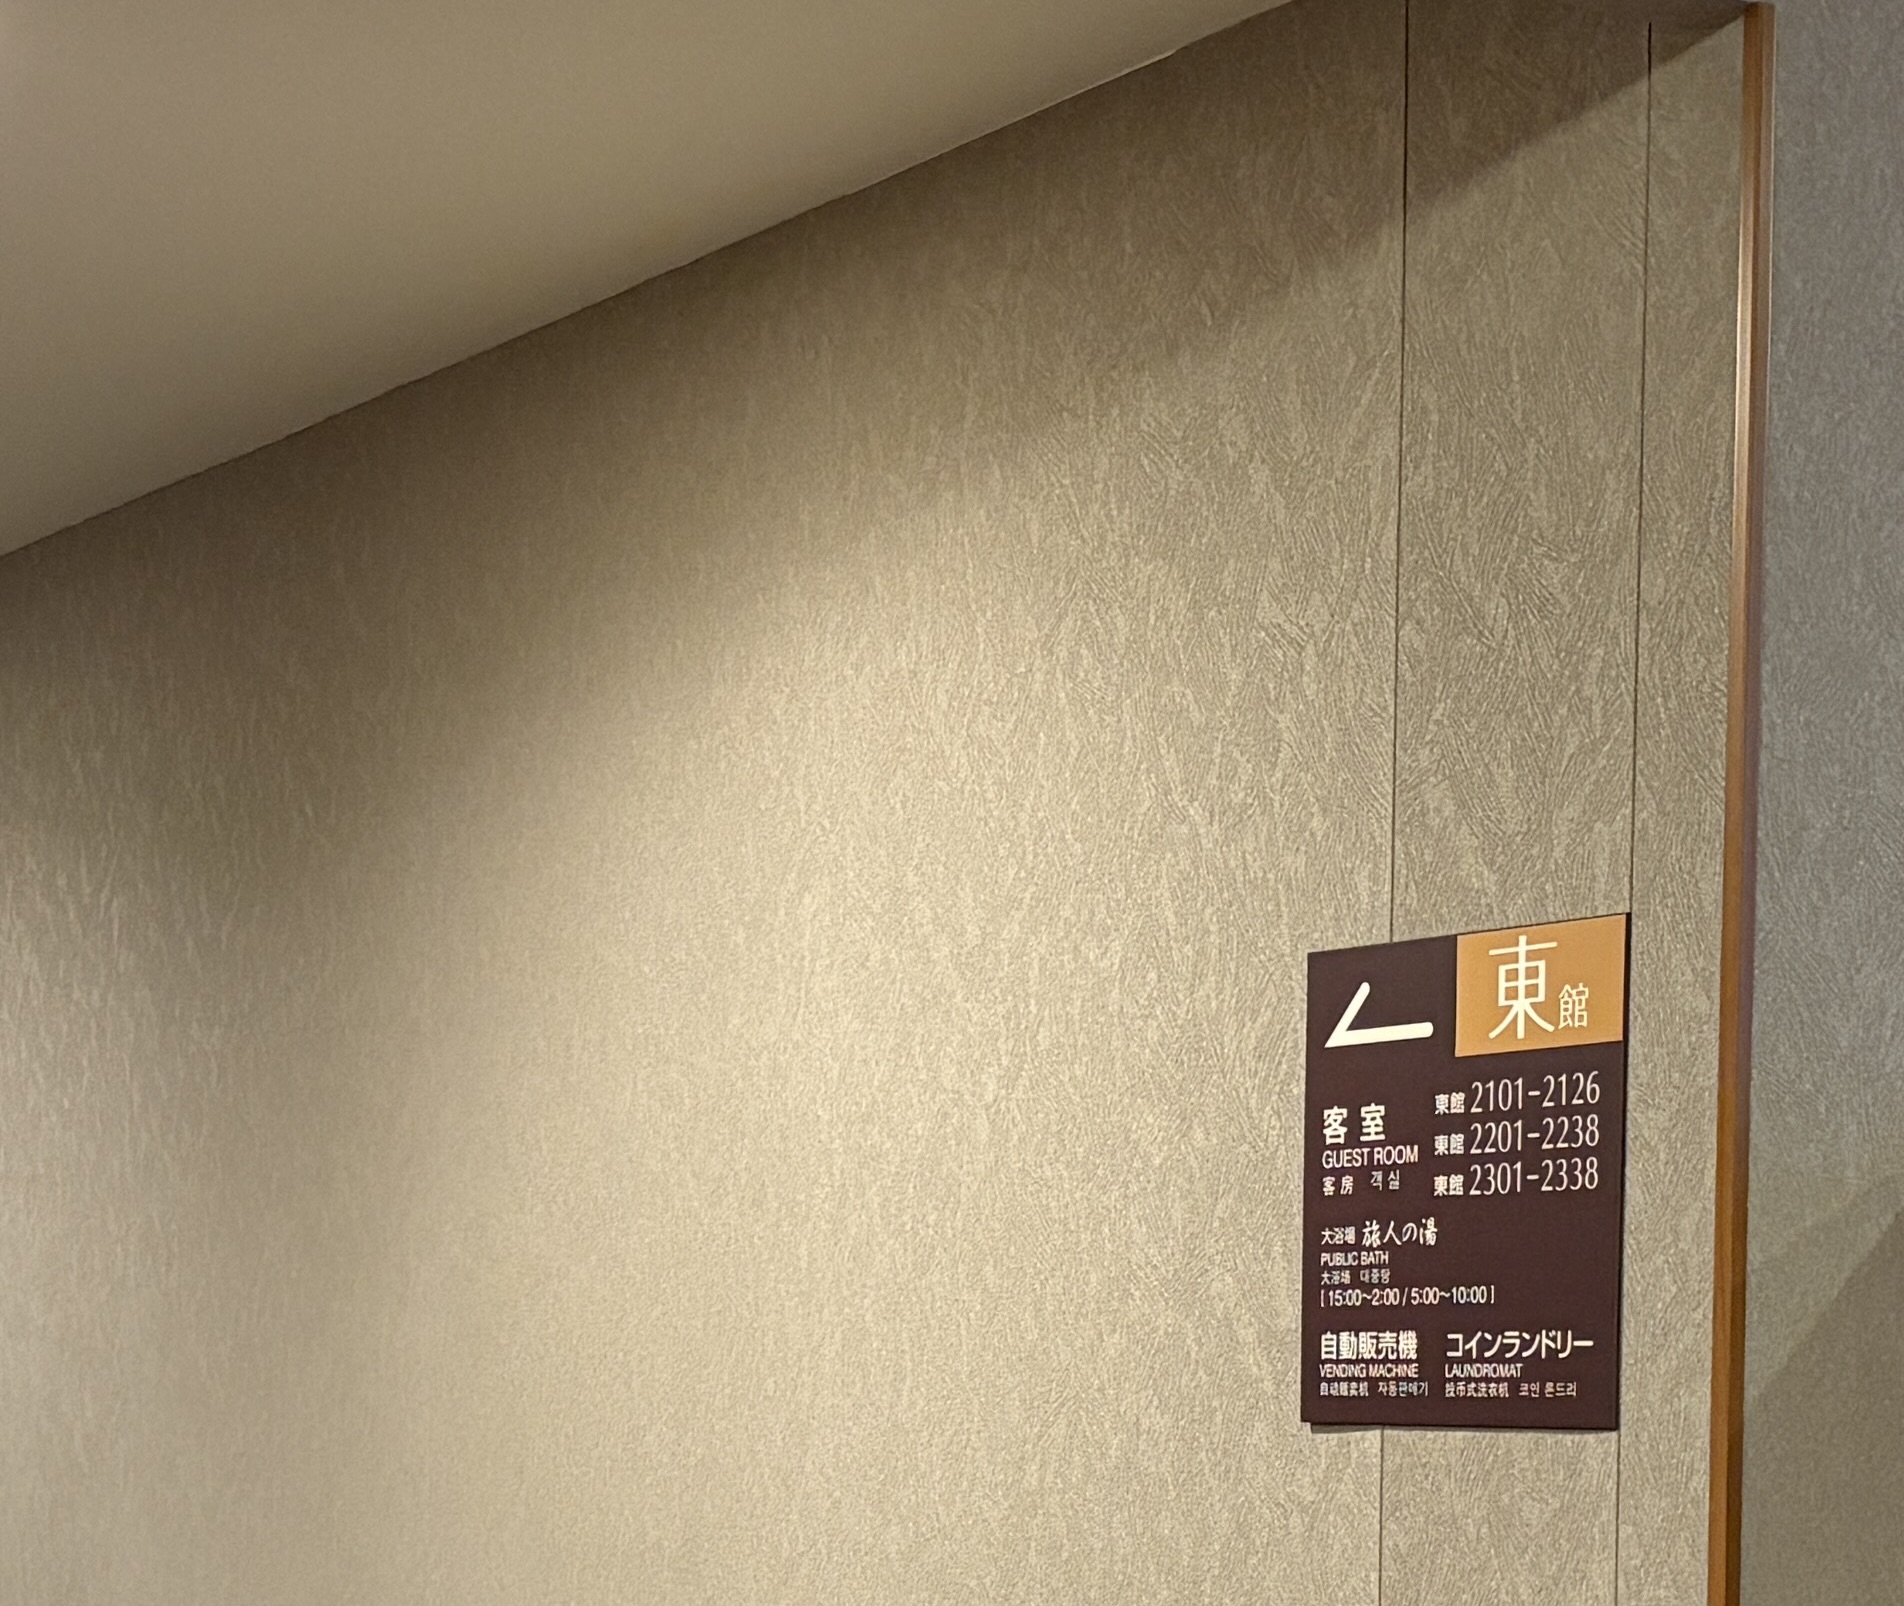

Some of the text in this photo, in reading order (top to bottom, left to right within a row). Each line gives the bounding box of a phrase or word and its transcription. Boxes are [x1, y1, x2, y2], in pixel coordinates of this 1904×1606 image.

[1488, 935, 1589, 1040] 東館
[1434, 1071, 1601, 1115] 東館 2101-2126
[1322, 1103, 1386, 1145] 客室
[1434, 1114, 1600, 1156] 東館 2201-2238
[1322, 1144, 1419, 1168] GUEST ROOM
[1433, 1156, 1599, 1196] 東館 2301-2338
[1361, 1216, 1438, 1248] 旅人の湯
[1320, 1250, 1389, 1266] PUBLIC BATH
[1321, 1330, 1418, 1360] 自動販売機
[1446, 1329, 1594, 1359] コインランドリー
[1319, 1363, 1419, 1378] VENDING MACHINE
[1445, 1363, 1523, 1378] LAUNDROMAT
